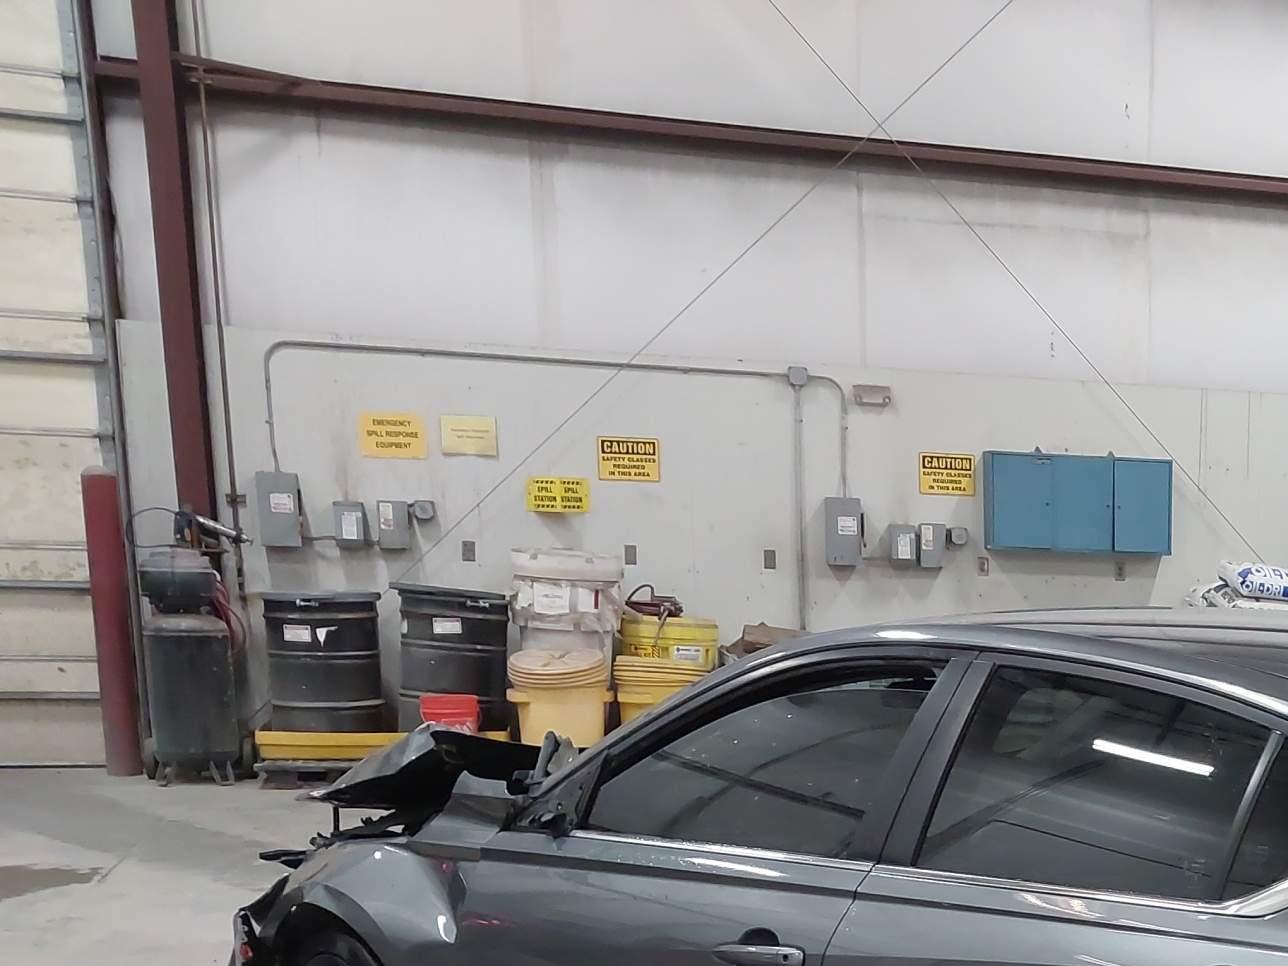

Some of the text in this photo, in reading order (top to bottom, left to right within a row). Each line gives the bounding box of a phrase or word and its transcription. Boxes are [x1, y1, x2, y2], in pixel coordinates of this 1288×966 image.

[372, 419, 411, 427] EMERGENCY
[385, 430, 418, 438] RESPONSE
[375, 441, 411, 449] EQUIPMENT
[603, 441, 654, 455] CAUTION
[924, 457, 970, 470] CAUTION
[533, 494, 557, 502] STATION
[560, 495, 583, 503] STATION
